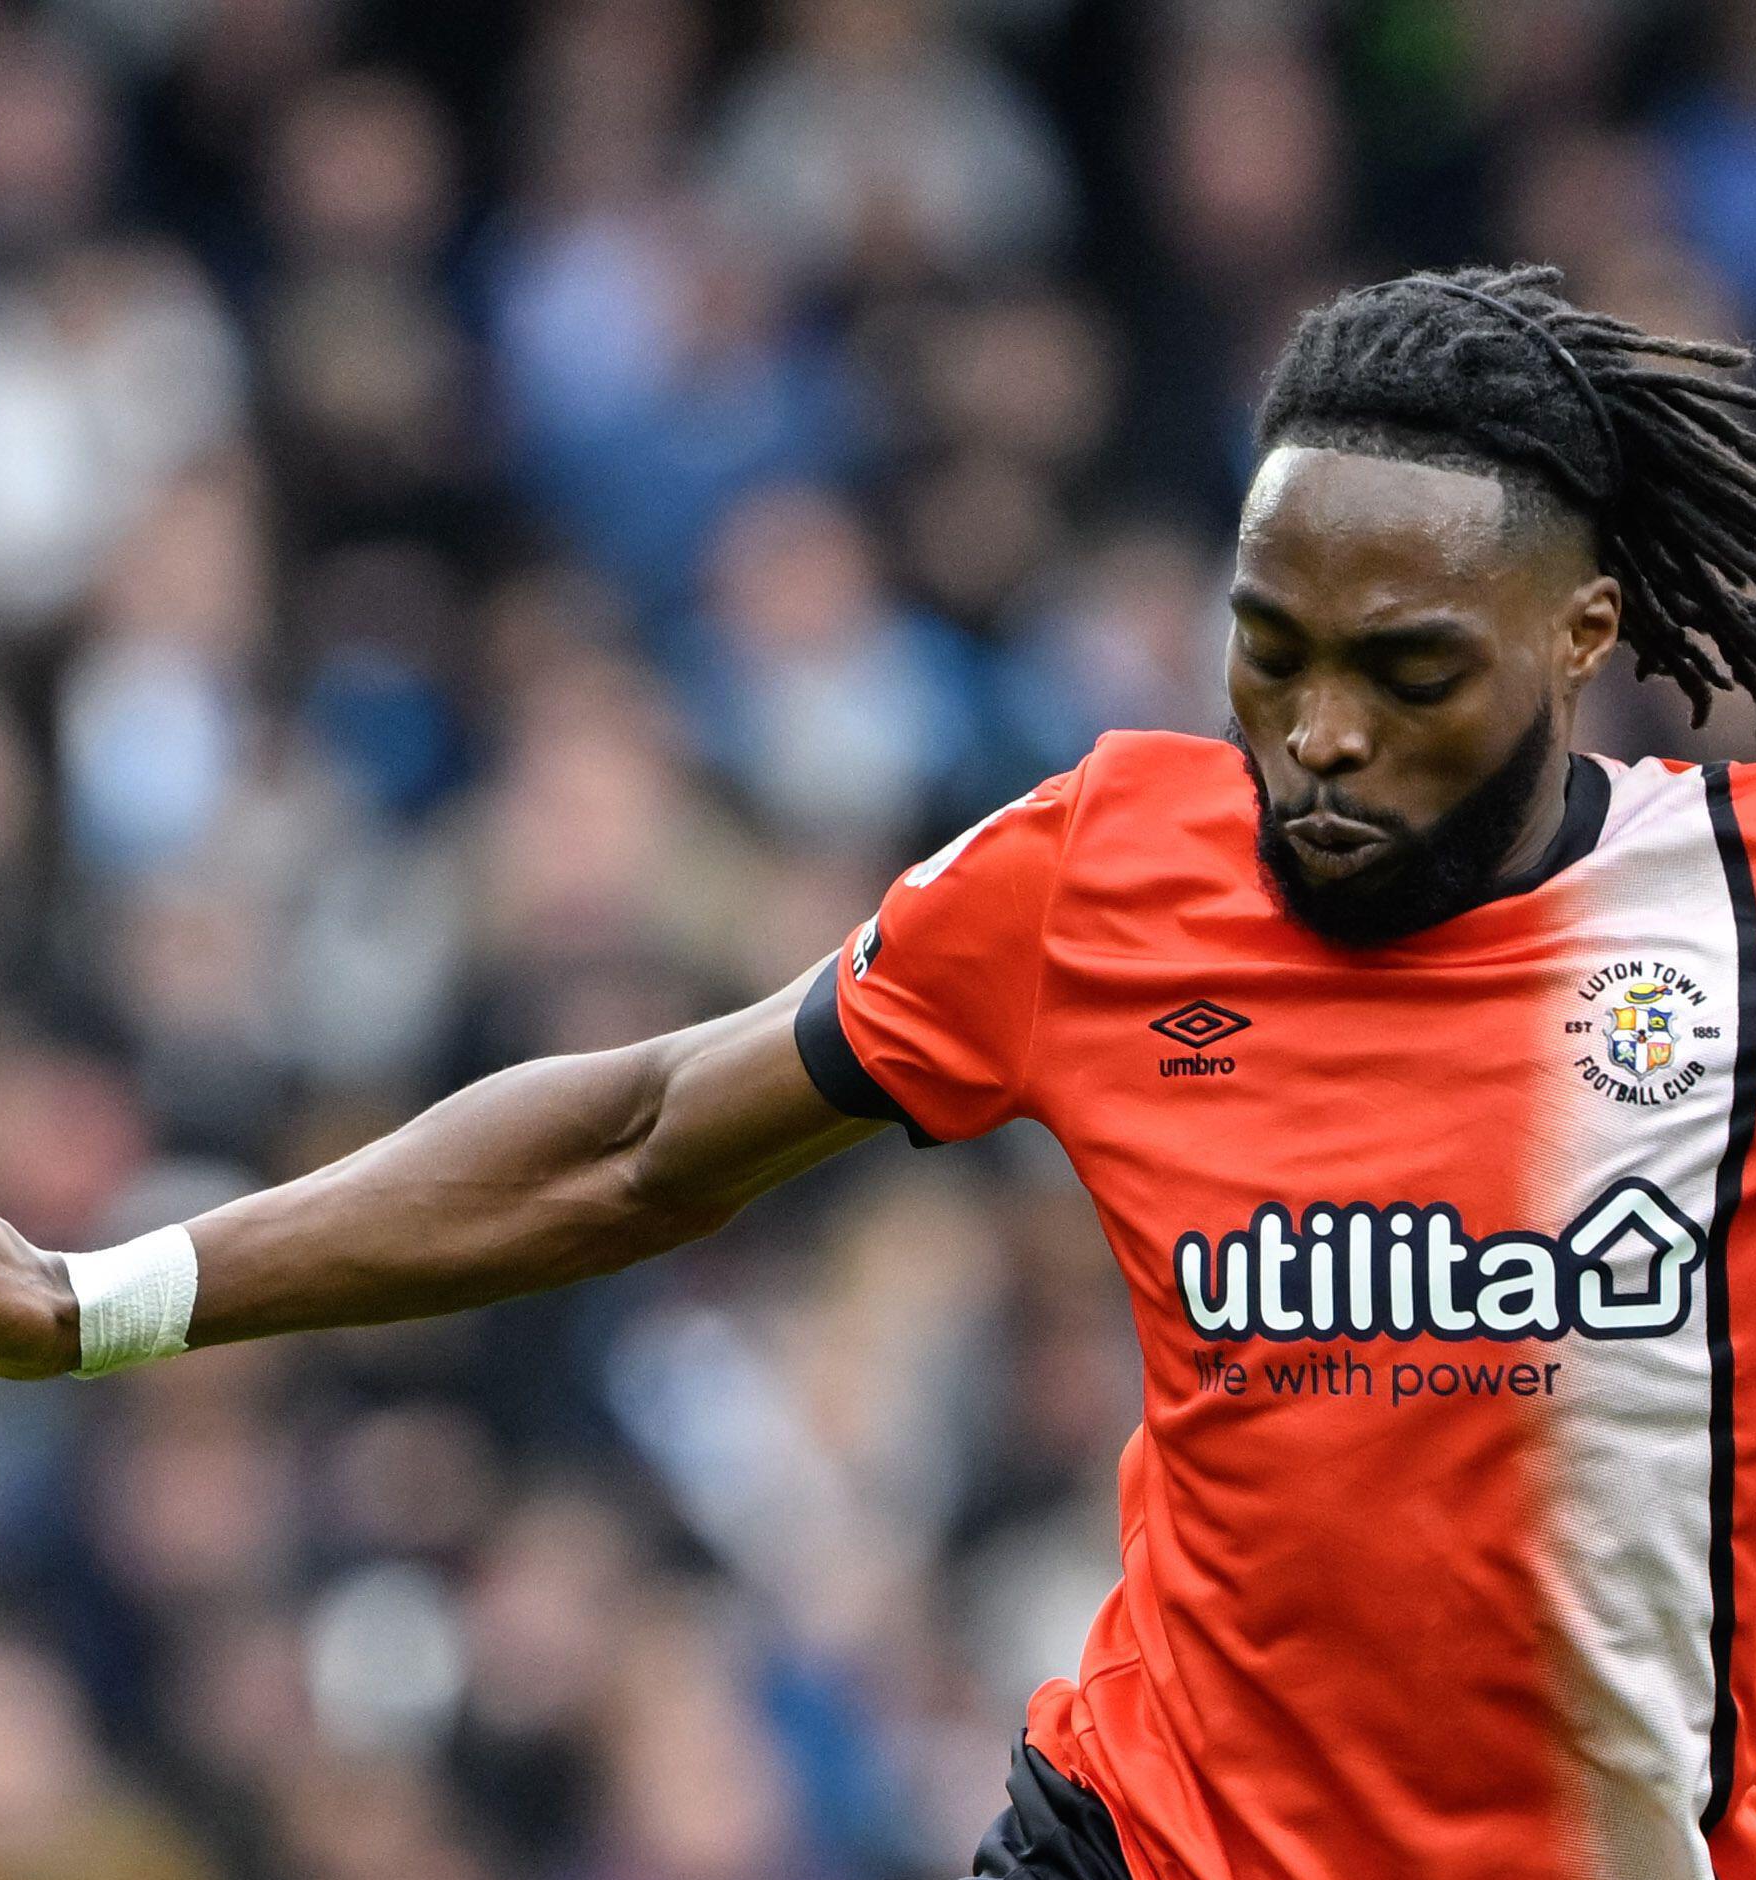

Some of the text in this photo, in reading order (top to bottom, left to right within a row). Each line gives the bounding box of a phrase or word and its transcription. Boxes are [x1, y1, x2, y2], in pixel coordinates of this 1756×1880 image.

[1578, 961, 1708, 1006] LUTON TOWN
[1565, 1021, 1593, 1033] EST
[1692, 1026, 1721, 1039] 1885
[1159, 1052, 1236, 1077] umbro
[1574, 1054, 1706, 1106] FOOTBALL CLUB
[1180, 1211, 1563, 1332] utilita
[1194, 1350, 1562, 1406] life with power
